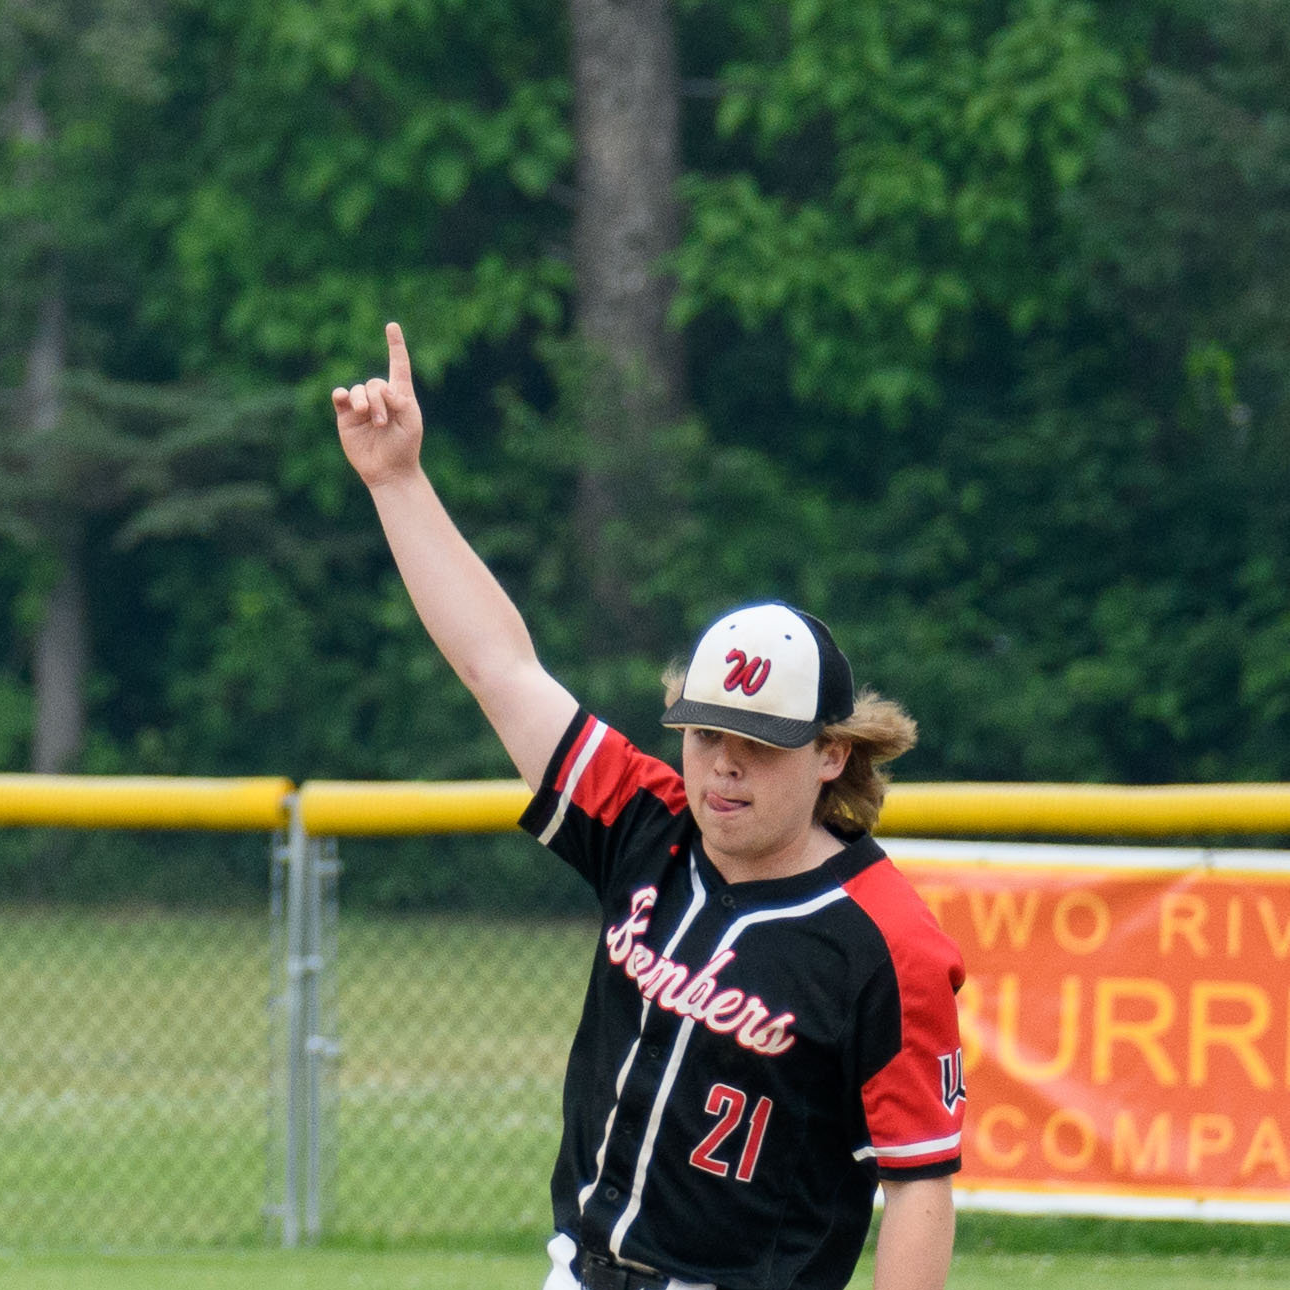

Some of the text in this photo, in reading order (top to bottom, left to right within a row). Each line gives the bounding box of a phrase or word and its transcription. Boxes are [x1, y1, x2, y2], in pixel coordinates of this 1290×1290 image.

[724, 648, 772, 697] W
[962, 974, 1290, 1090] URR
[689, 1083, 773, 1183] 21
[975, 1103, 1290, 1179] COMPA
